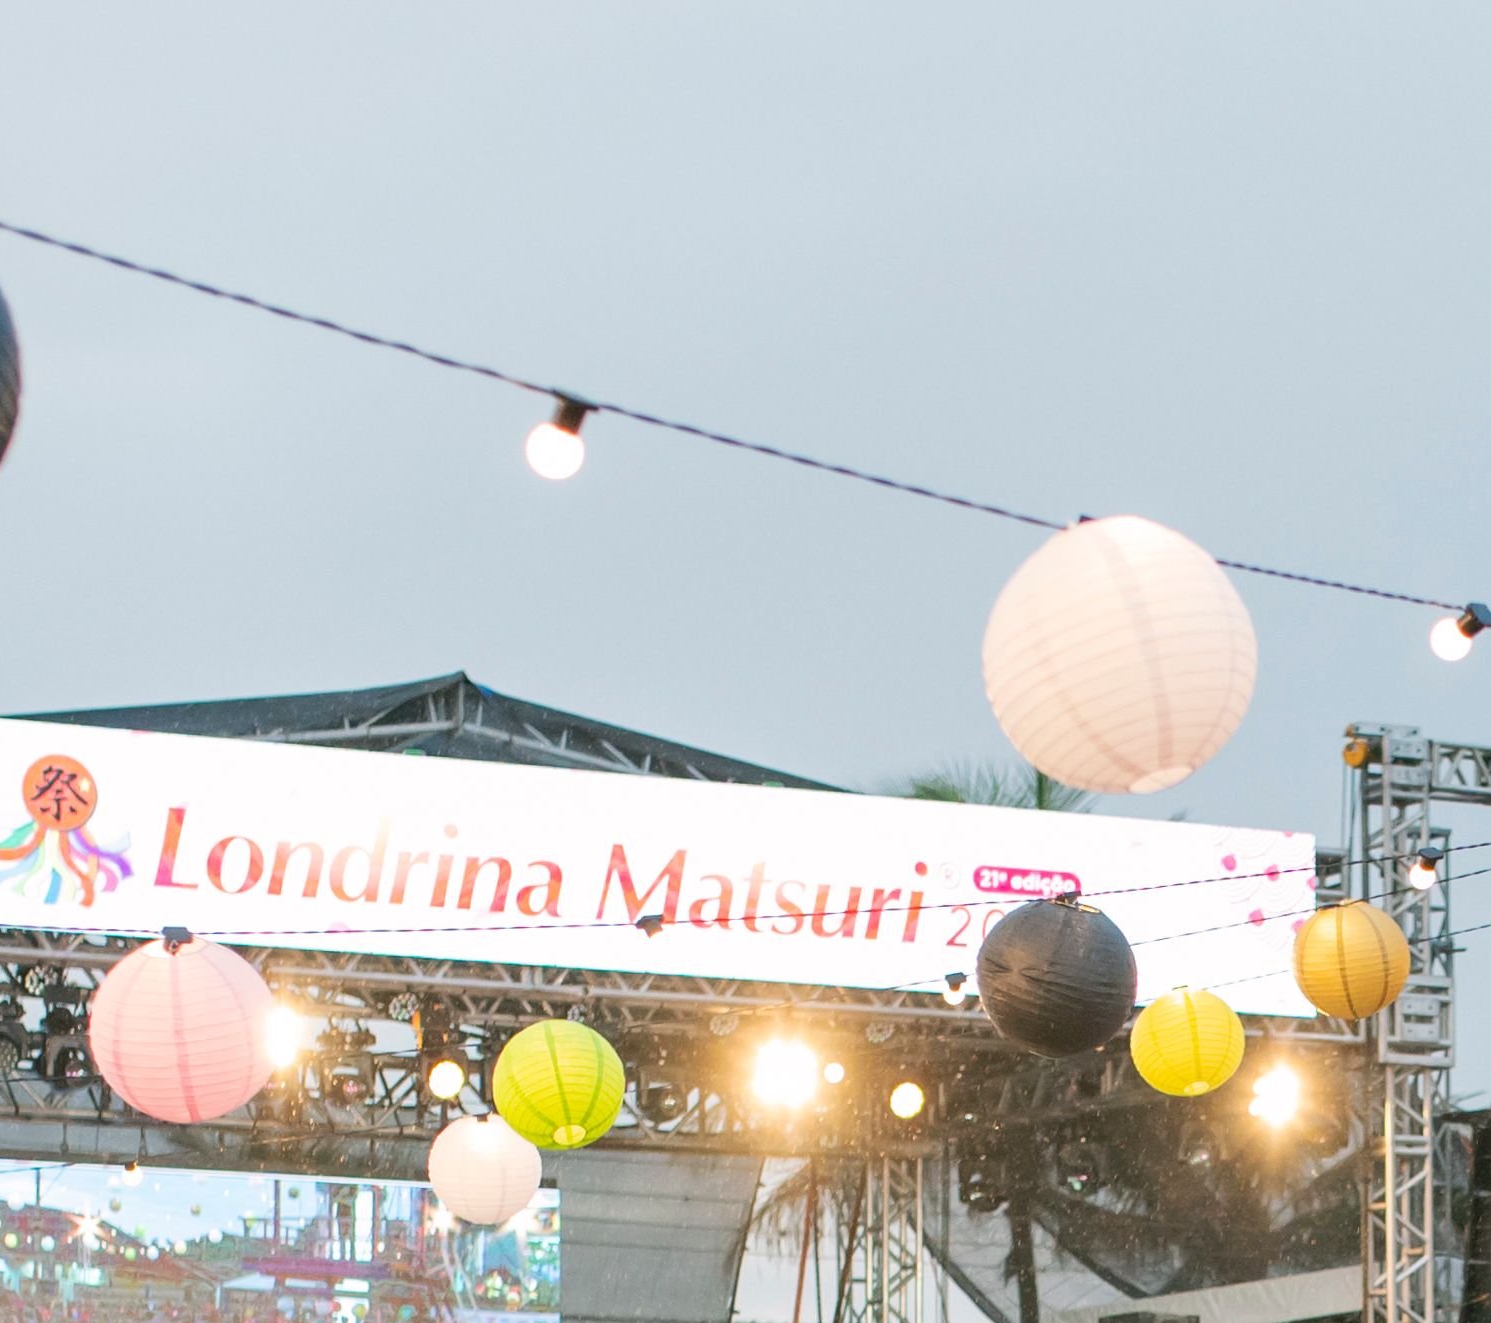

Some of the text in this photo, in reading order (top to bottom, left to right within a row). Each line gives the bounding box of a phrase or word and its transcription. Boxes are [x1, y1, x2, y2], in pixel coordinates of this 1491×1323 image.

[30, 764, 89, 821] 祭
[154, 806, 929, 943] Londrina Matsuri
